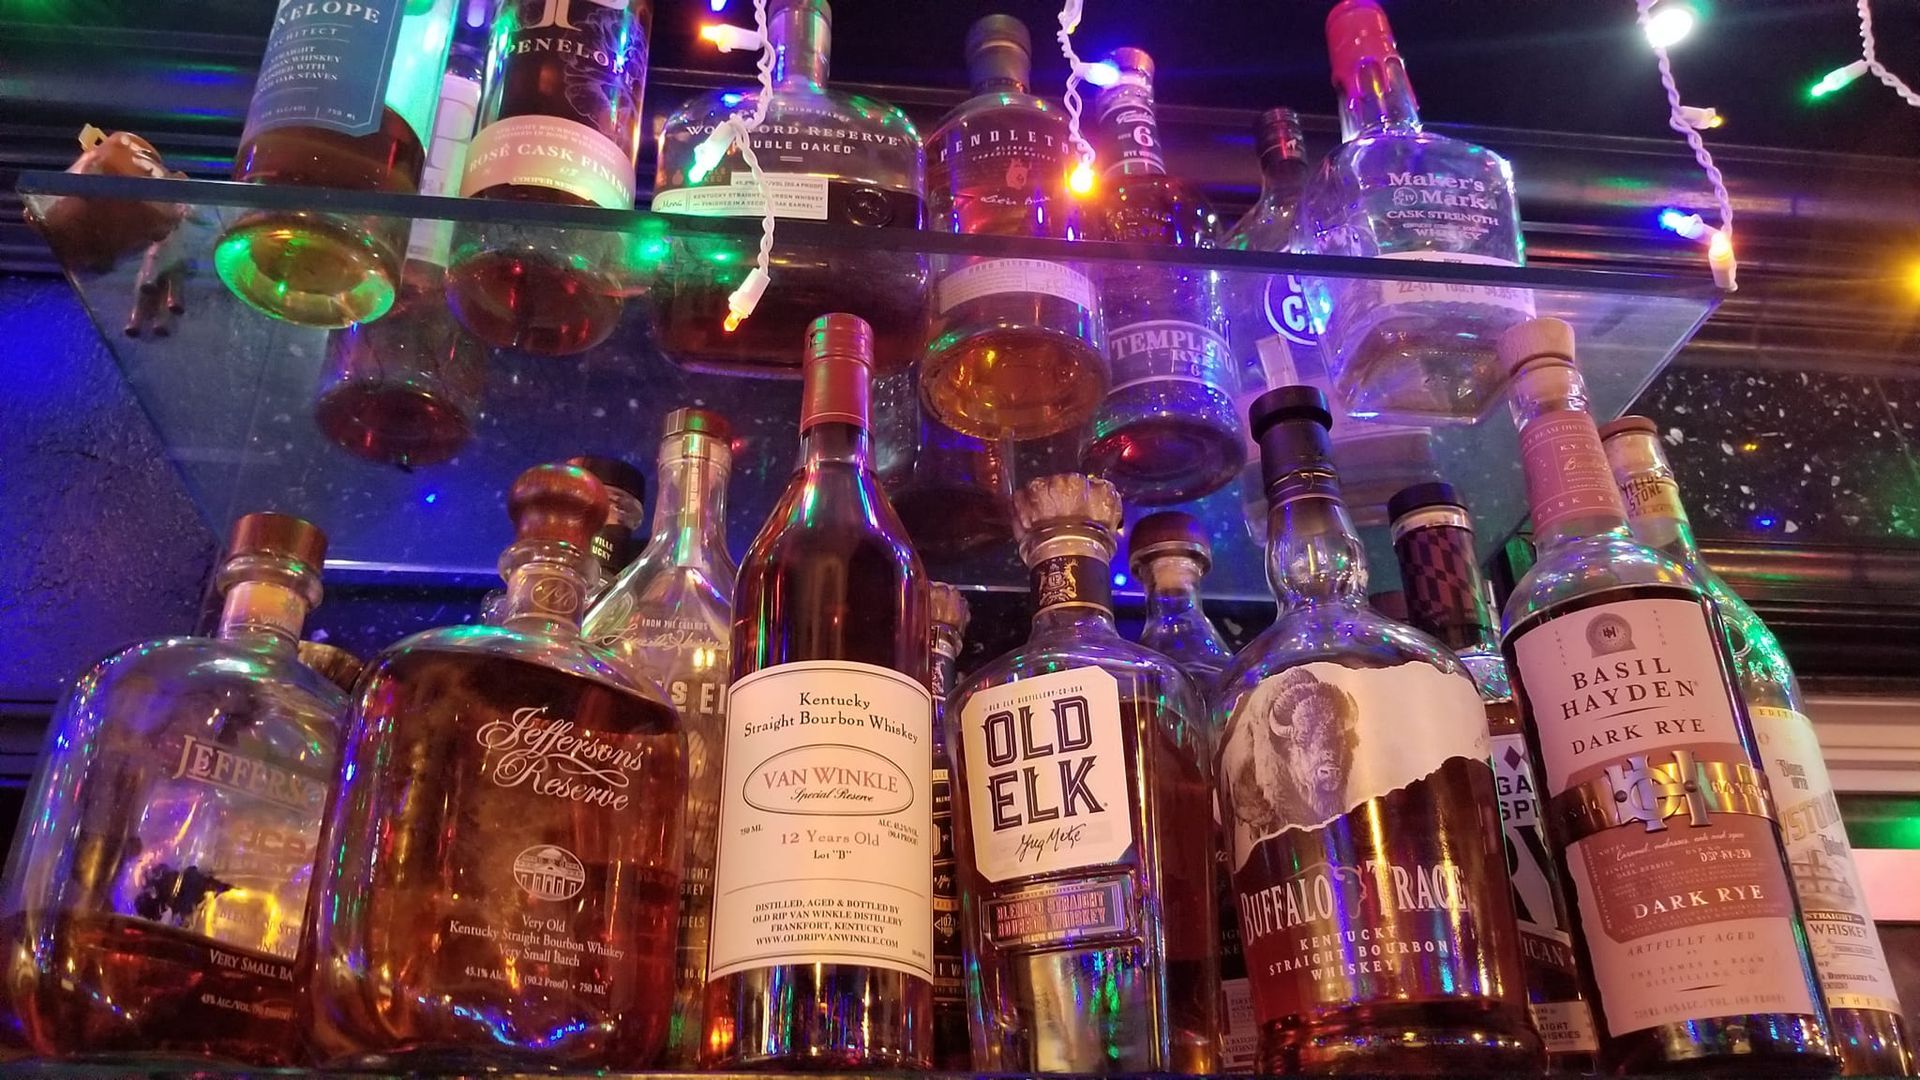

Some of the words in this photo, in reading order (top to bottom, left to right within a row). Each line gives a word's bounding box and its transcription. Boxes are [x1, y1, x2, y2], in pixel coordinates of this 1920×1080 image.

[294, 70, 338, 81] STAVES
[808, 123, 899, 147] RESERVE
[1133, 125, 1154, 147] 6
[517, 143, 574, 162] CASK
[753, 139, 793, 150] UBLE
[800, 141, 852, 155] OAKED
[1387, 171, 1486, 192] Maker's
[1419, 190, 1489, 210] Mark
[1386, 209, 1426, 219] CASK
[1427, 210, 1500, 226] STRENGTH
[1629, 482, 1662, 511] STONE
[641, 618, 661, 628] FROM
[1571, 657, 1672, 692] BASIL
[799, 691, 871, 711] Kentucky
[988, 703, 1001, 712] OLD
[1003, 699, 1015, 709] ELK
[1560, 680, 1697, 721] HAYDEN
[476, 706, 645, 771] Jefferson's
[743, 713, 795, 738] Straight
[799, 710, 865, 728] Bourbon
[868, 714, 919, 745] Whiskey
[980, 694, 1093, 768] OLD
[1571, 724, 1643, 756] DARK
[1654, 718, 1706, 735] RYE
[493, 749, 631, 811] Reserve
[763, 767, 808, 790] VAN
[811, 766, 899, 794] WINKLE
[790, 787, 832, 803] Special
[833, 787, 875, 802] Reserve
[986, 755, 1106, 833] ELK
[750, 823, 764, 834] ML
[781, 832, 800, 846] 12
[806, 829, 851, 844] Years
[853, 830, 881, 847] Old
[813, 849, 831, 860] Lot
[832, 849, 853, 861] "B"
[754, 898, 806, 912] DISTILLED,
[807, 898, 836, 908] AGED
[836, 899, 845, 908] &
[846, 899, 889, 913] BOTTLED
[889, 905, 900, 915] BY
[1046, 890, 1105, 915] STRAIGHT
[1240, 873, 1334, 947] BUFFALO
[1365, 858, 1468, 917] TRACE
[1632, 890, 1709, 920] DARK
[1716, 884, 1765, 903] RYE
[522, 914, 544, 932] Very
[546, 918, 566, 933] Old
[752, 913, 771, 925] OLD
[772, 911, 788, 922] RIP
[789, 910, 811, 920] VAN
[812, 910, 853, 920] WINKLE
[853, 911, 904, 928] DISTILLERY
[770, 922, 832, 934] FRANKFORT,
[833, 922, 886, 935] KENTUCKY
[1051, 906, 1106, 930] WHISKEY
[450, 919, 499, 940] Kentucky
[502, 928, 541, 946] Straight
[543, 934, 585, 952] Bourbon
[587, 940, 625, 961] Whiskey
[756, 932, 899, 949] WWW.OLDRIPVANWINKLE.COM
[1299, 926, 1398, 951] KENTUCKY
[1809, 922, 1867, 939] WHISKEY
[499, 943, 522, 959] Very
[523, 948, 551, 963] Small
[553, 951, 581, 967] Batch
[1627, 935, 1706, 957] ARTFULLY
[1714, 931, 1756, 943] AGED
[210, 948, 239, 969] VERY
[240, 956, 276, 978] SMALL
[1269, 949, 1346, 977] STRAIGHT
[1358, 939, 1449, 959] BOURBON
[1660, 960, 1703, 975] JAMES
[1730, 956, 1766, 965] BEAM
[1310, 958, 1395, 982] WHISKEY
[1645, 970, 1734, 988] DISTILLING
[524, 974, 544, 987] (90.2
[544, 976, 569, 990] Proof)
[579, 982, 593, 994] 750
[593, 984, 607, 996] ML
